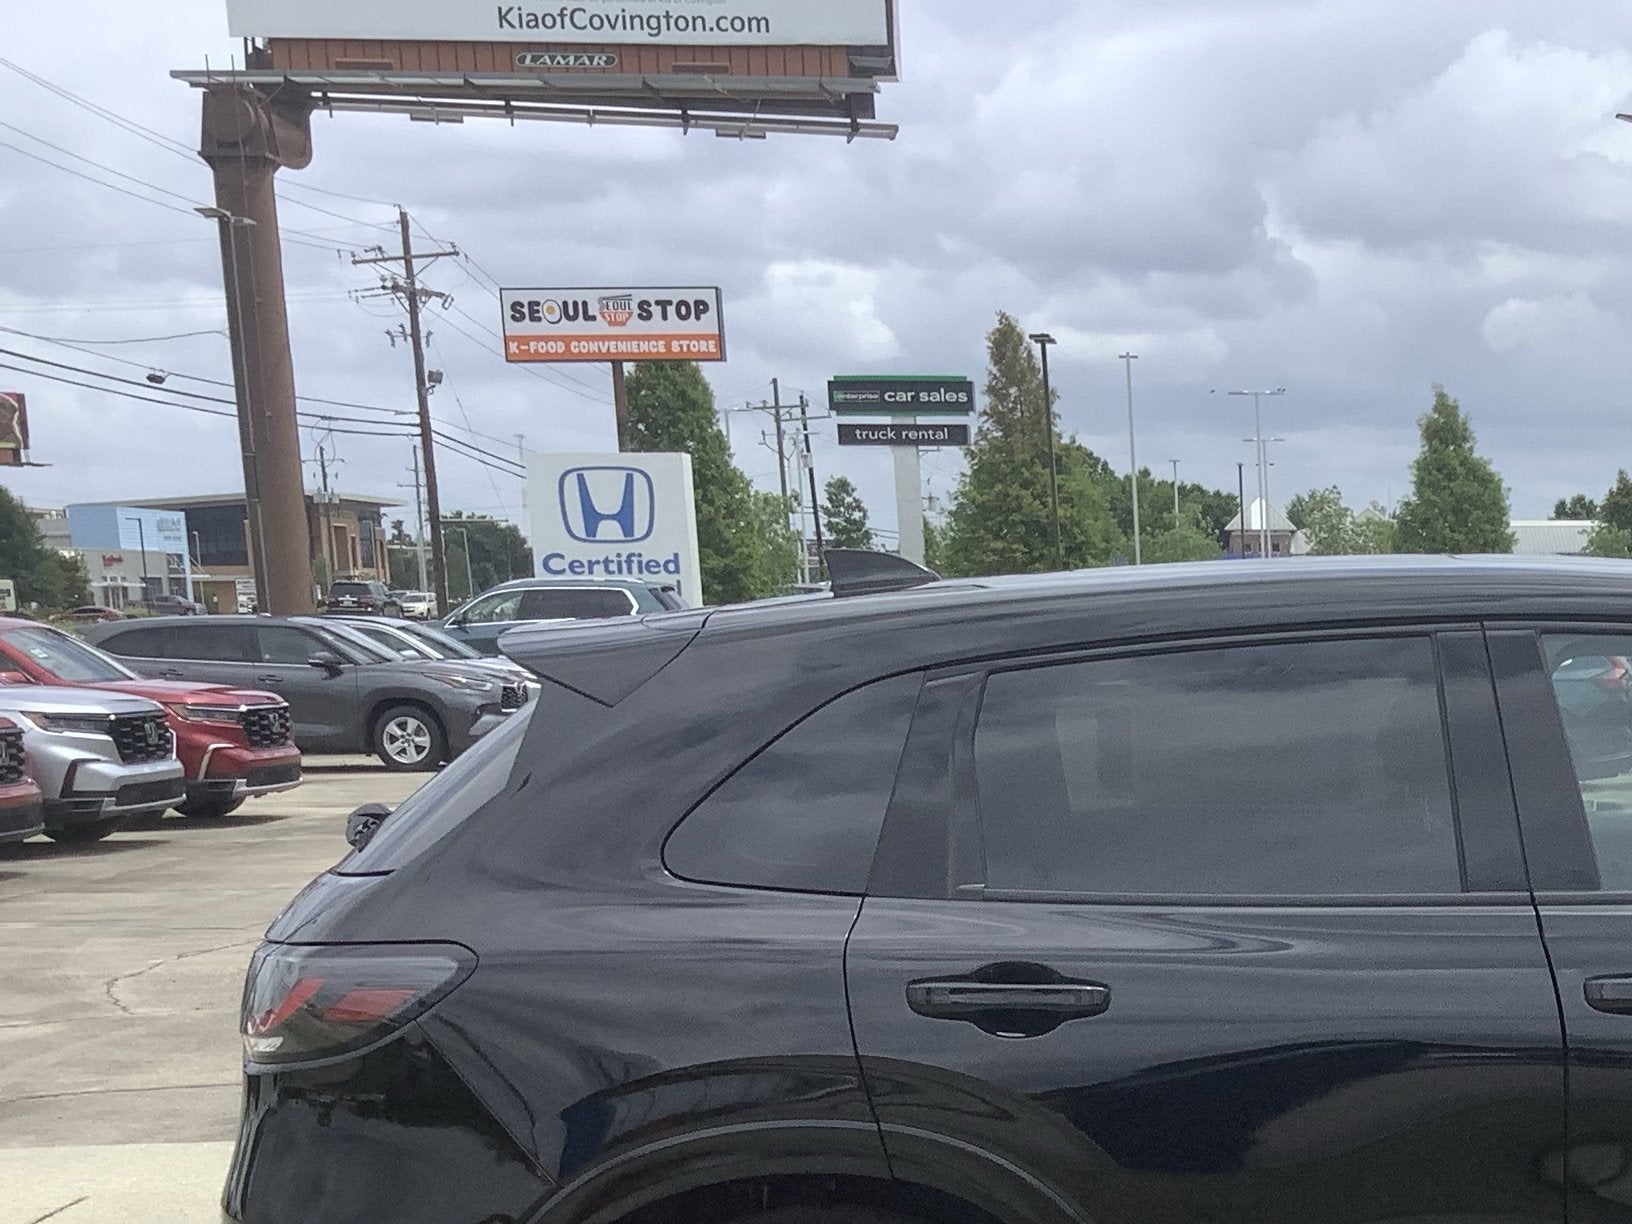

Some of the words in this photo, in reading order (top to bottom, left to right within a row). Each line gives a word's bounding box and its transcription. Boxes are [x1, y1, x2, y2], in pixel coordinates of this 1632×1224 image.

[497, 6, 771, 37] KiaofCovington.com
[524, 54, 609, 67] LAMAR
[510, 299, 597, 324] SEOUL
[637, 299, 710, 322] STOP
[605, 312, 629, 322] STOP
[508, 341, 566, 354] K-FOOD
[570, 340, 666, 354] CONVENIENCE
[671, 340, 717, 353] STORE
[884, 390, 916, 403] car
[919, 387, 968, 403] sales
[855, 427, 896, 440] truck
[902, 427, 948, 440] rental
[542, 552, 680, 575] Certified
